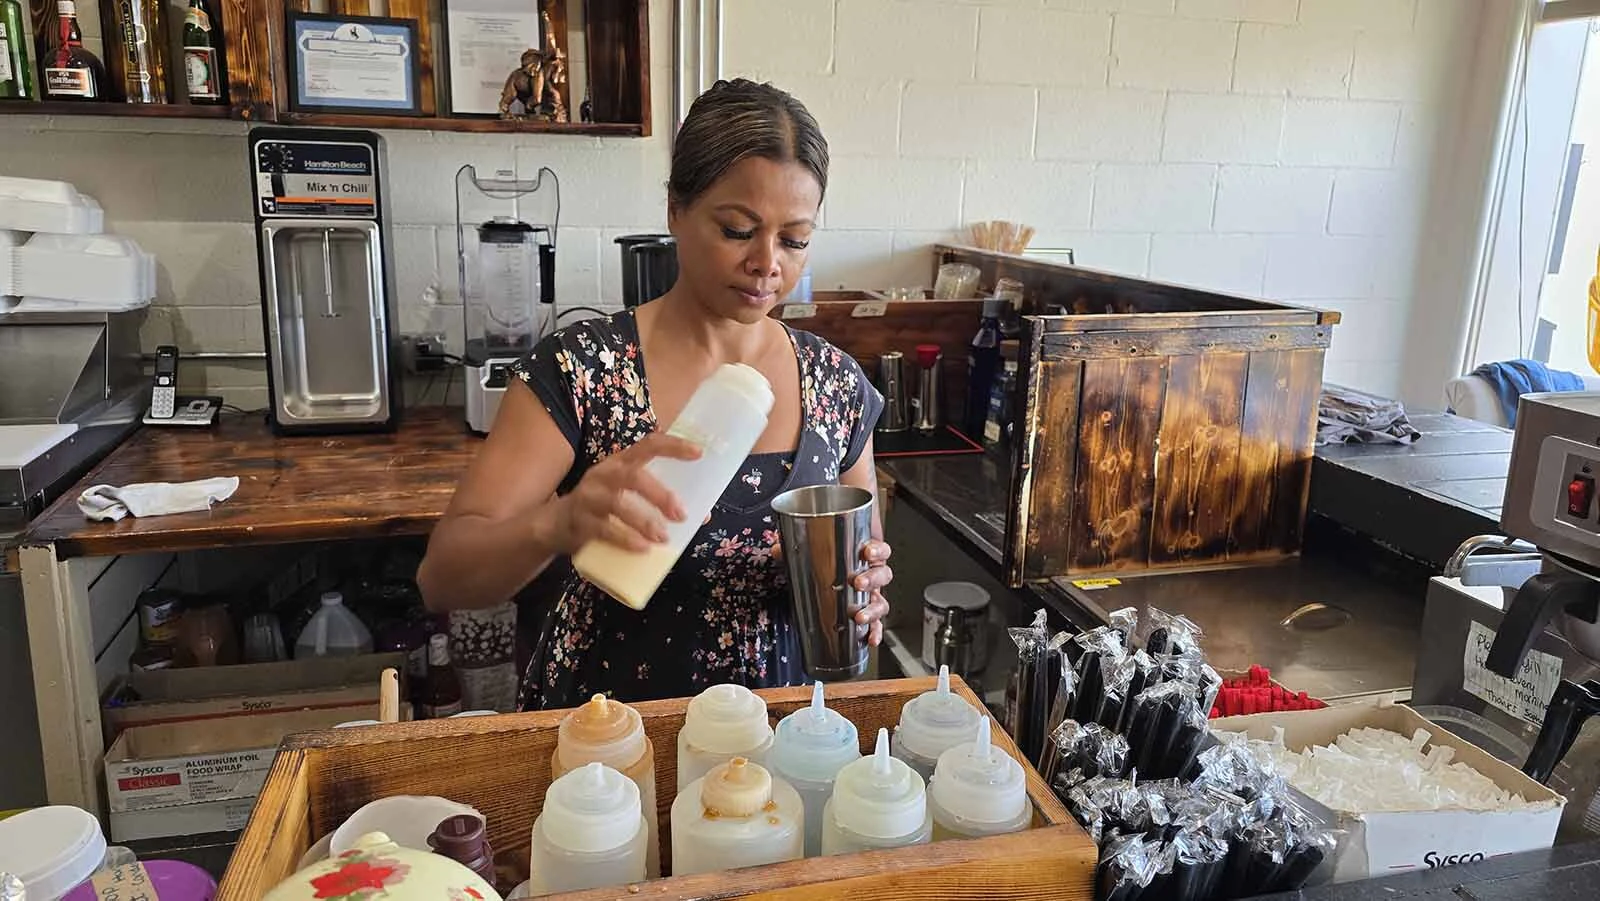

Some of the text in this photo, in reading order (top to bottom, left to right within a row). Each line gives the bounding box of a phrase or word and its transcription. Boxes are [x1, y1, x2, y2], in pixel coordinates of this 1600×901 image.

[304, 160, 366, 169] Hamilton Beach
[306, 182, 327, 193] Mix
[342, 183, 367, 193] Chill
[243, 701, 271, 711] Sysco
[186, 753, 260, 769] ALUMINUM FOIL
[132, 766, 164, 776] Sysco
[187, 766, 214, 775] FOOD
[215, 764, 243, 773] WRAP
[1424, 851, 1484, 869] Sysco
